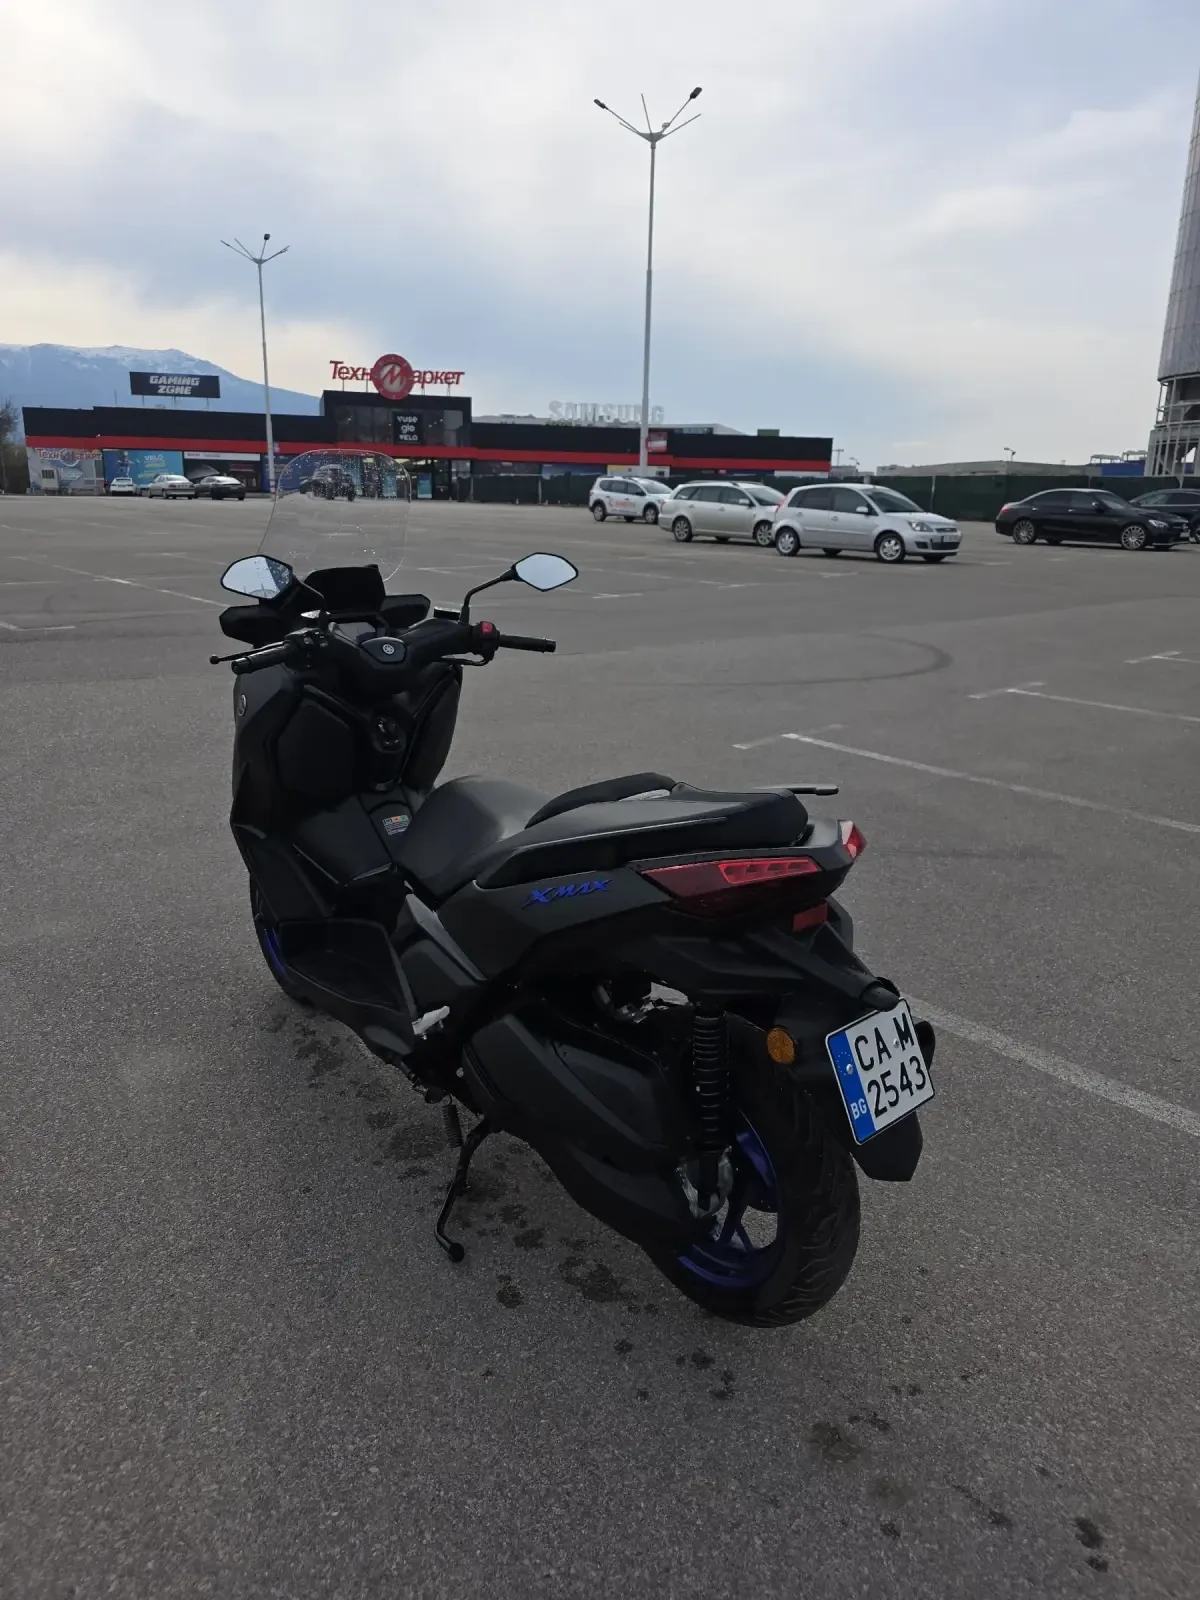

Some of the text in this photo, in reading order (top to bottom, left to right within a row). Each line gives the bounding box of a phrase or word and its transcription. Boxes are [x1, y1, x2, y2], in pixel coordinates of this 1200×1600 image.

[149, 375, 200, 386] GAMING
[549, 400, 665, 424] SAMSUNG
[867, 1055, 926, 1118] 2543
[850, 1098, 868, 1120] BG
